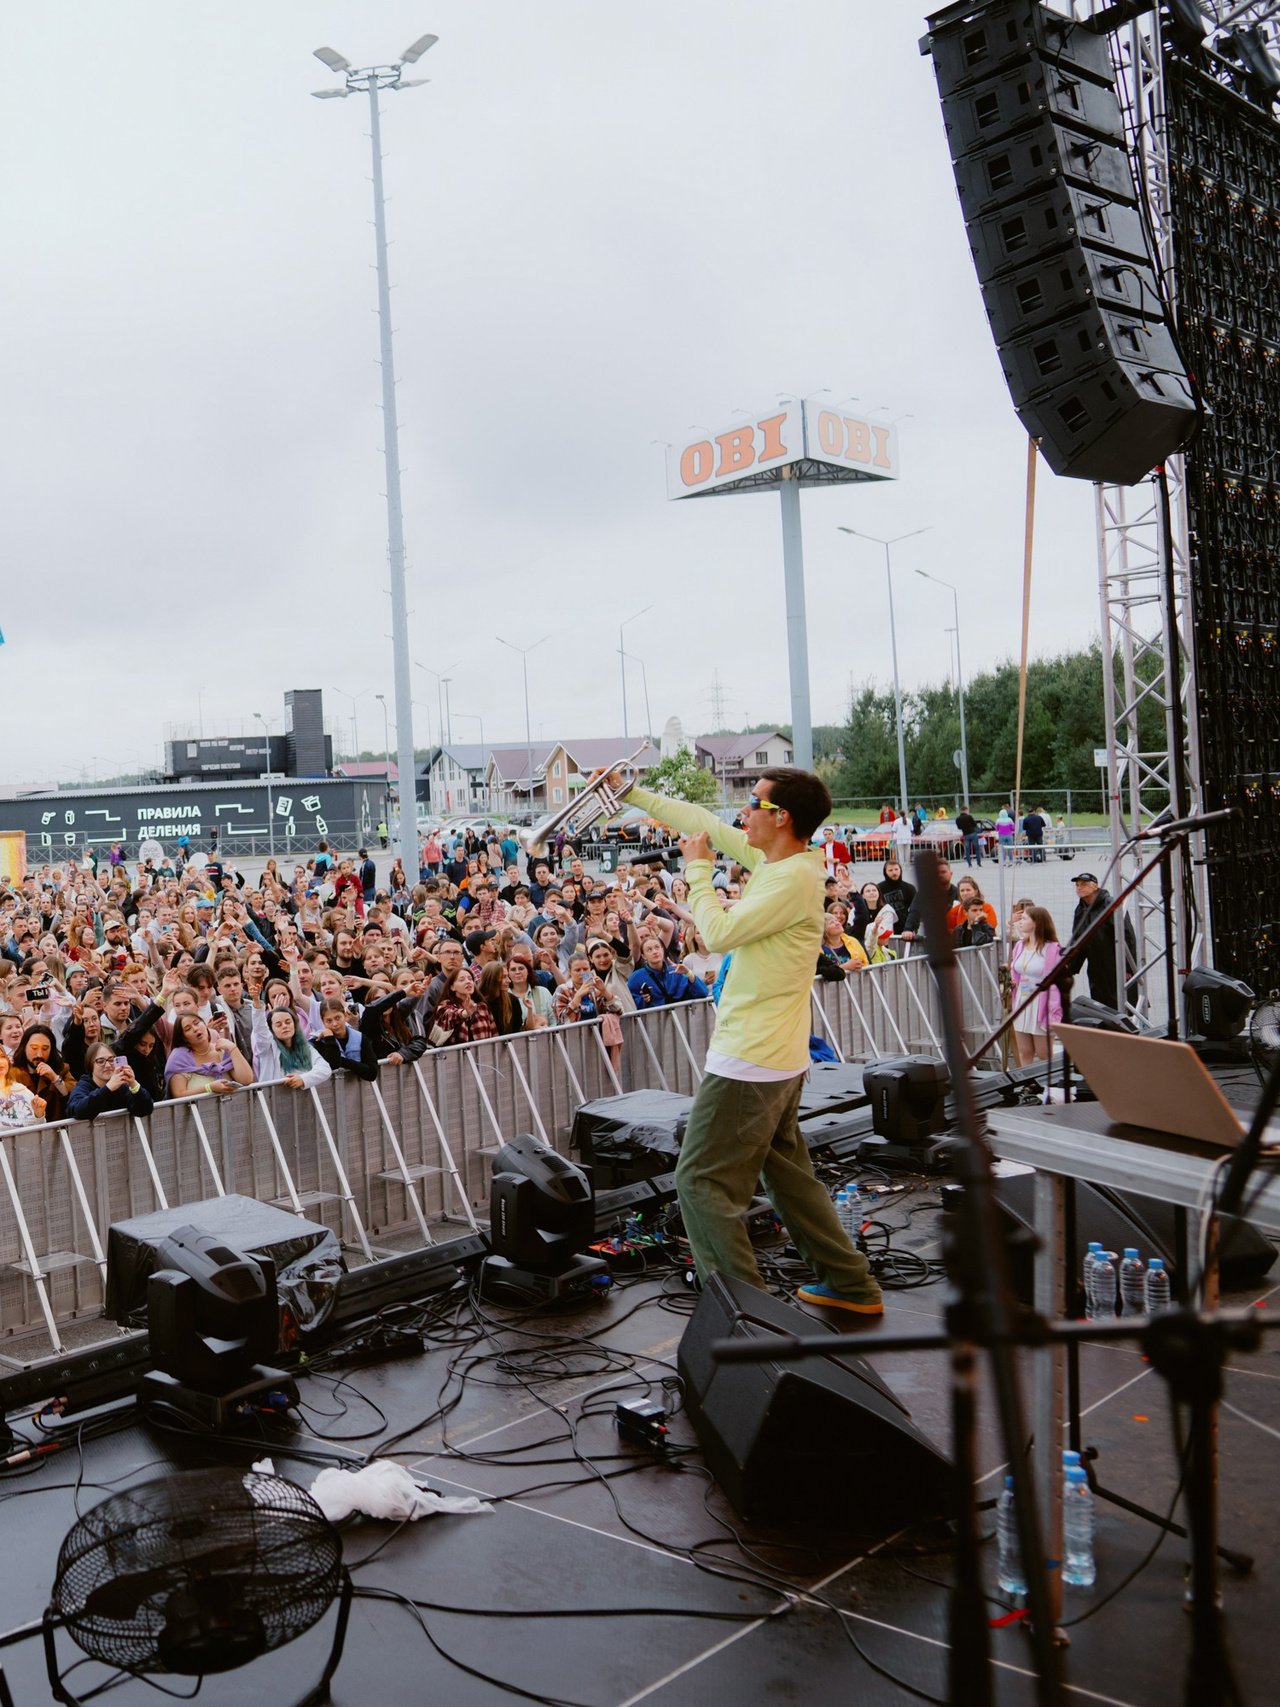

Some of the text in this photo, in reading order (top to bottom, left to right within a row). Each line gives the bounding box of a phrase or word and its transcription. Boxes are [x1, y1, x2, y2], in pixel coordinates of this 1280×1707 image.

[680, 412, 788, 487] OBI
[818, 410, 891, 469] OBI
[137, 805, 202, 820] ПРАВИЛА
[137, 824, 201, 840] ДЕЛЕНИЯ
